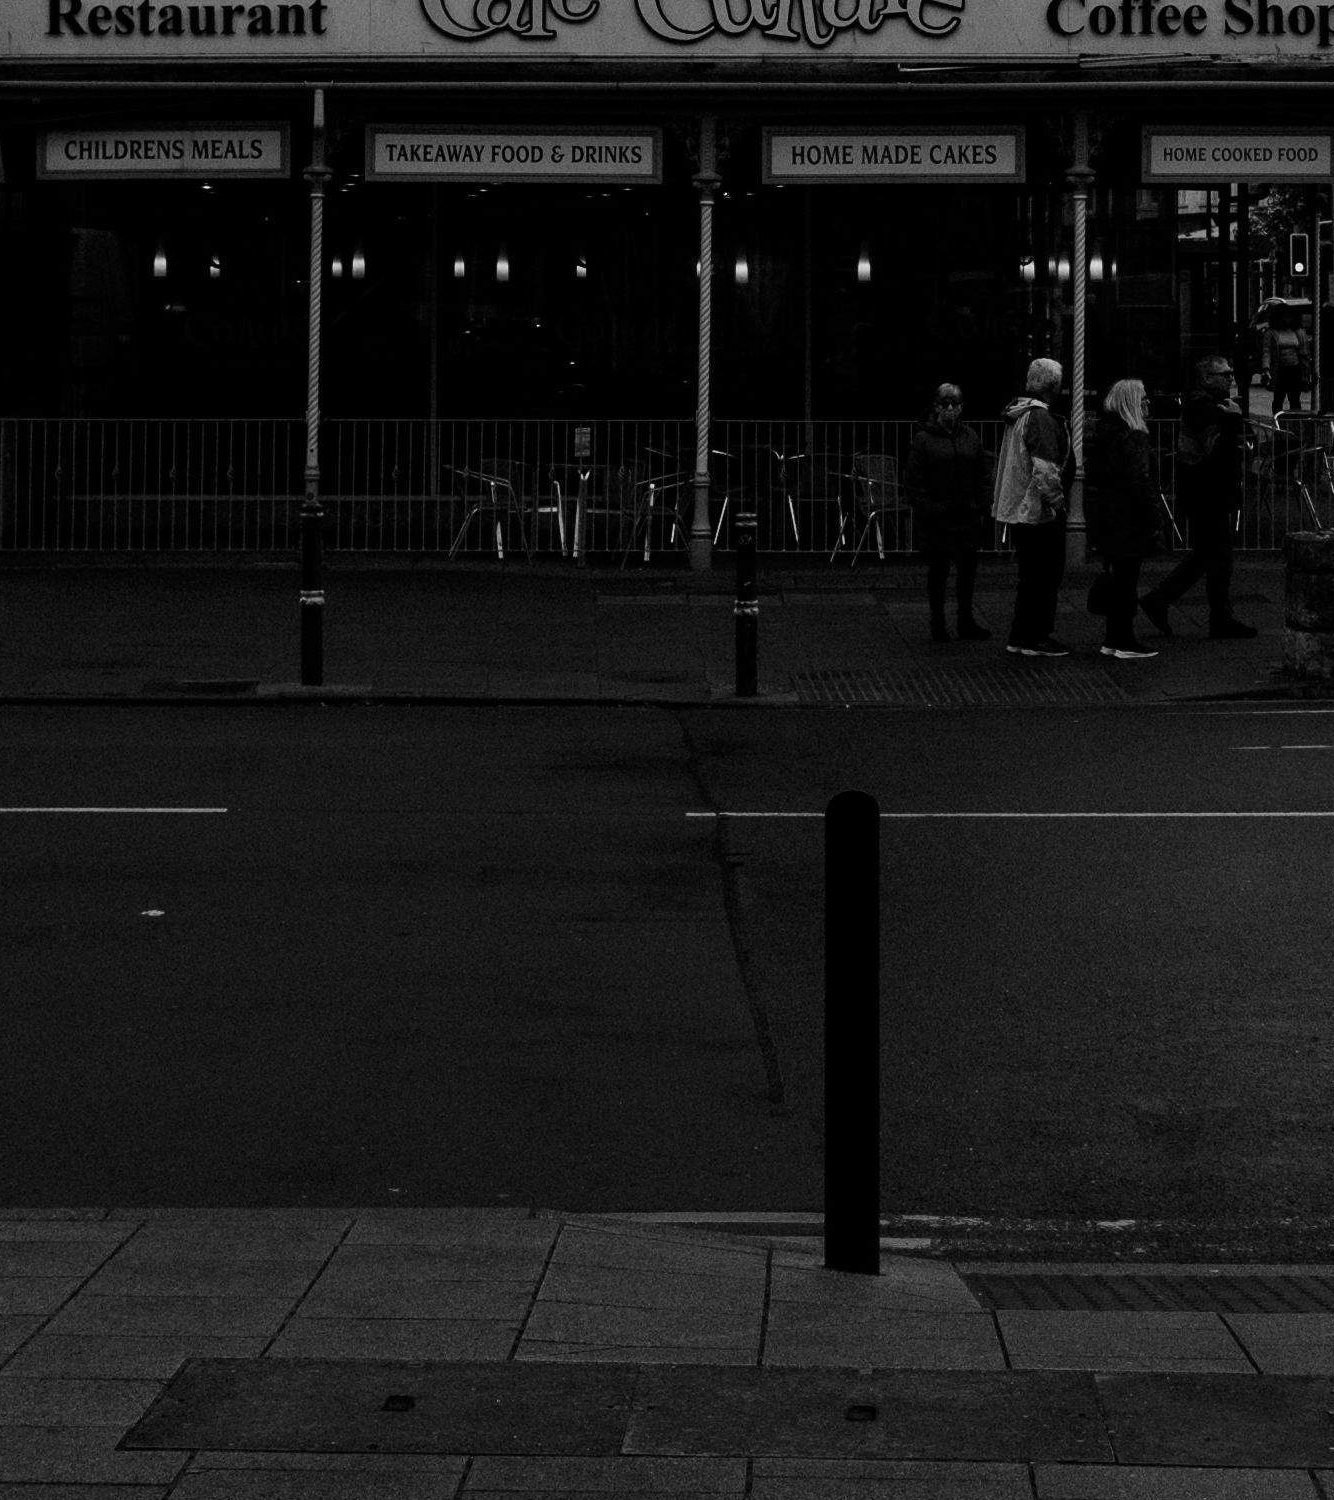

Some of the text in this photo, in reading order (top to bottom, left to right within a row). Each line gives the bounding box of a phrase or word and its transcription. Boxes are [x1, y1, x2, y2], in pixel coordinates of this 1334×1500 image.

[64, 139, 263, 162] CHILDRENS MEALS
[385, 143, 643, 164] TAKEAWAY FOOD & DRINKS
[791, 144, 998, 166] HOME MADE CAKES
[1162, 146, 1319, 163] HOME COOKED FOOD
